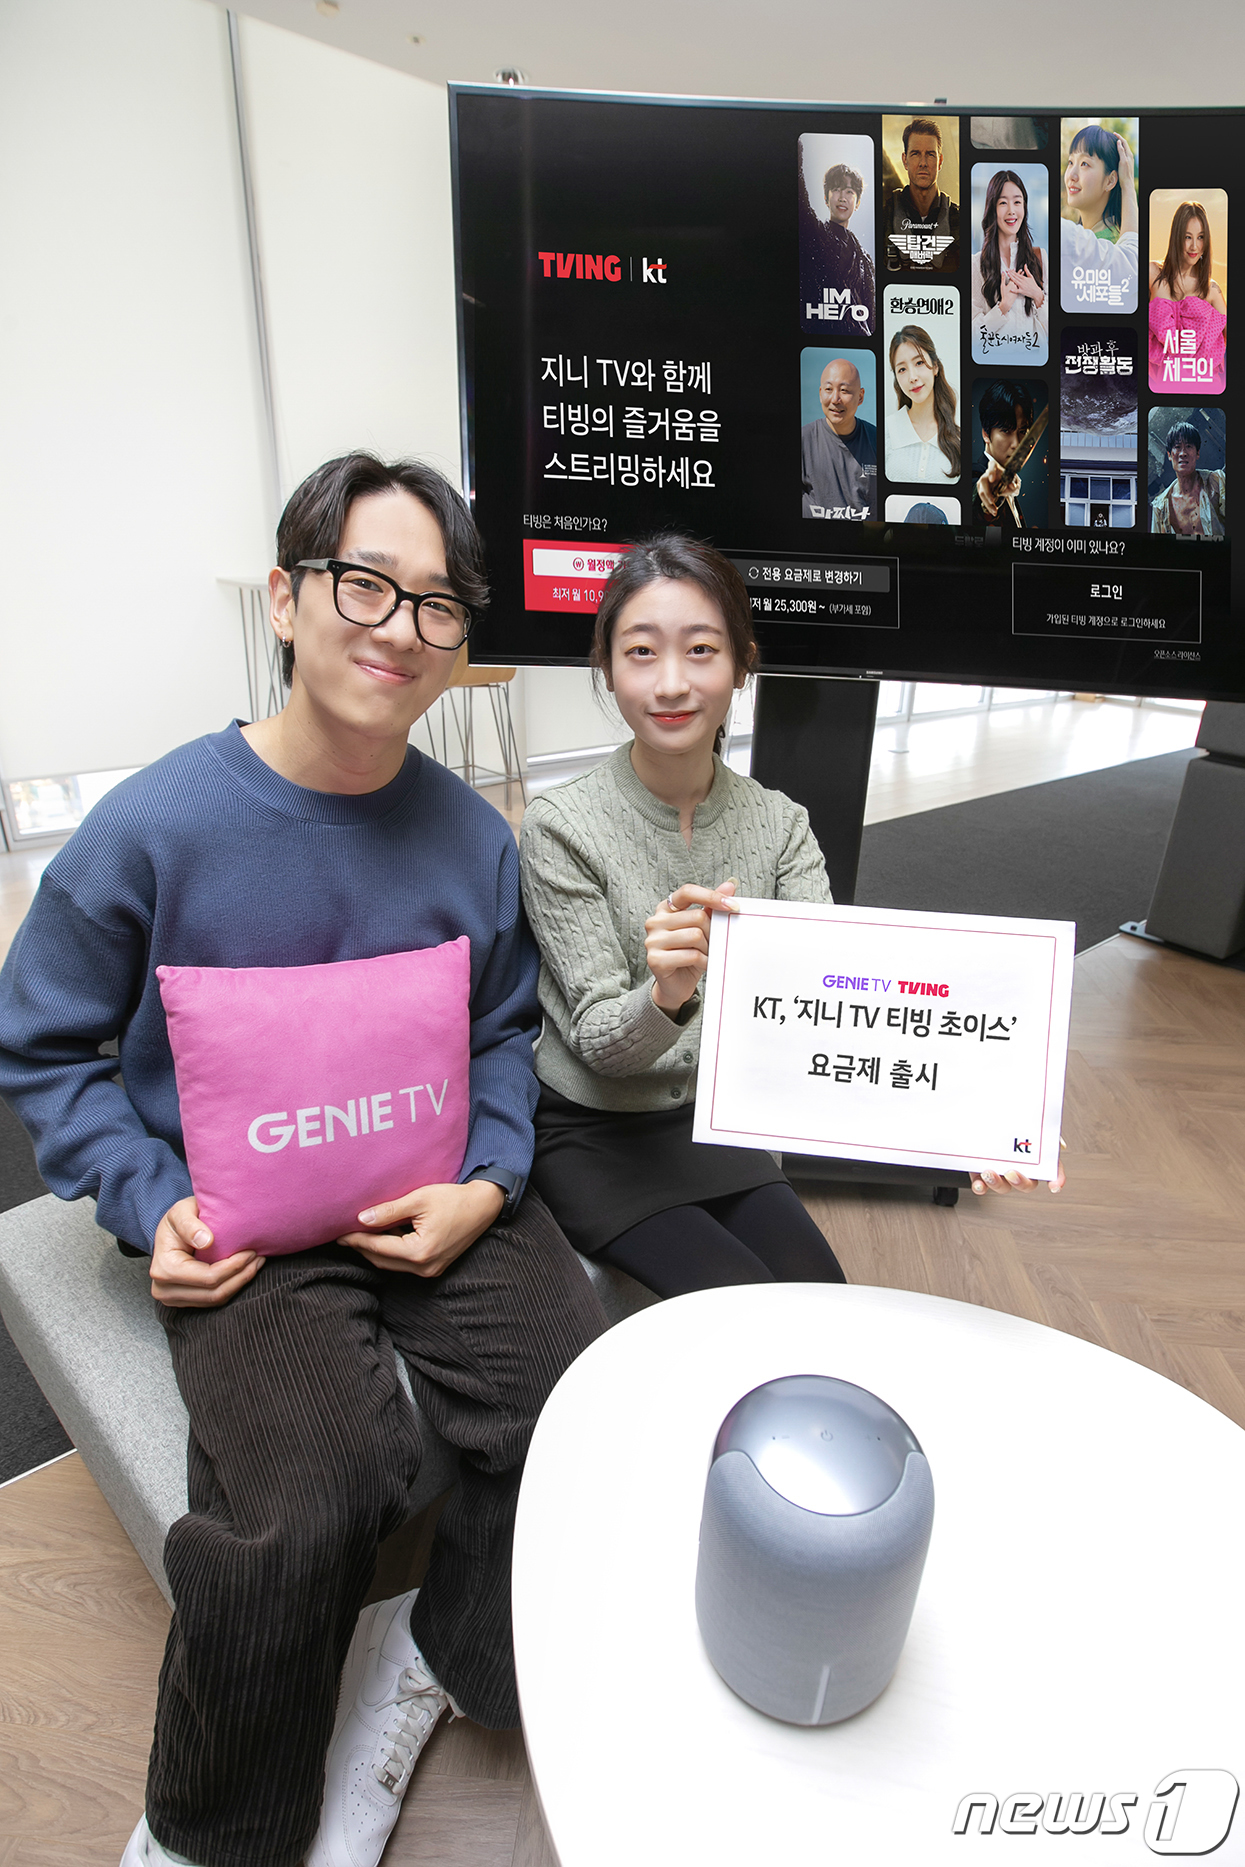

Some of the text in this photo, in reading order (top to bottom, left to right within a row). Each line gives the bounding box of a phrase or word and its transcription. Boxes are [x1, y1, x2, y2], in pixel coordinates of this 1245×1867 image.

[907, 235, 936, 251] 탑건
[538, 251, 667, 283] TVING kt
[1071, 266, 1111, 289] 유미의
[823, 287, 851, 304] IM
[890, 297, 954, 316] 환승연애2
[1077, 341, 1103, 357] 방과
[1163, 329, 1197, 354] 서울
[541, 354, 711, 394] 지니 TV와 함께
[1064, 355, 1134, 376] 전쟁활동
[1163, 356, 1213, 382] 체크인
[543, 402, 721, 442] 티빙의 즐거움을
[543, 452, 716, 490] 스트리밍하세요
[523, 514, 608, 532] 티빙은 처음인가요?
[1012, 537, 1125, 555] 티빙 계정이 이미 있나요?
[762, 567, 862, 585] 전용 요금제로 변경하기
[552, 587, 570, 601] 최저
[572, 589, 581, 601] 월
[1090, 584, 1123, 600] 로그인
[749, 597, 761, 611] 저
[763, 598, 772, 611] 월
[828, 603, 853, 615] (부가세
[1046, 613, 1166, 629] 가입된 티빙 계정으로 로그인하세요
[822, 974, 949, 998] GENIE TV TVING
[753, 996, 786, 1025] KT,
[849, 1004, 880, 1029] TV
[886, 1006, 932, 1038] 티빙
[807, 1053, 938, 1091] 요금제 출시
[247, 1078, 448, 1153] GENIE TV
[1013, 1138, 1032, 1154] kt
